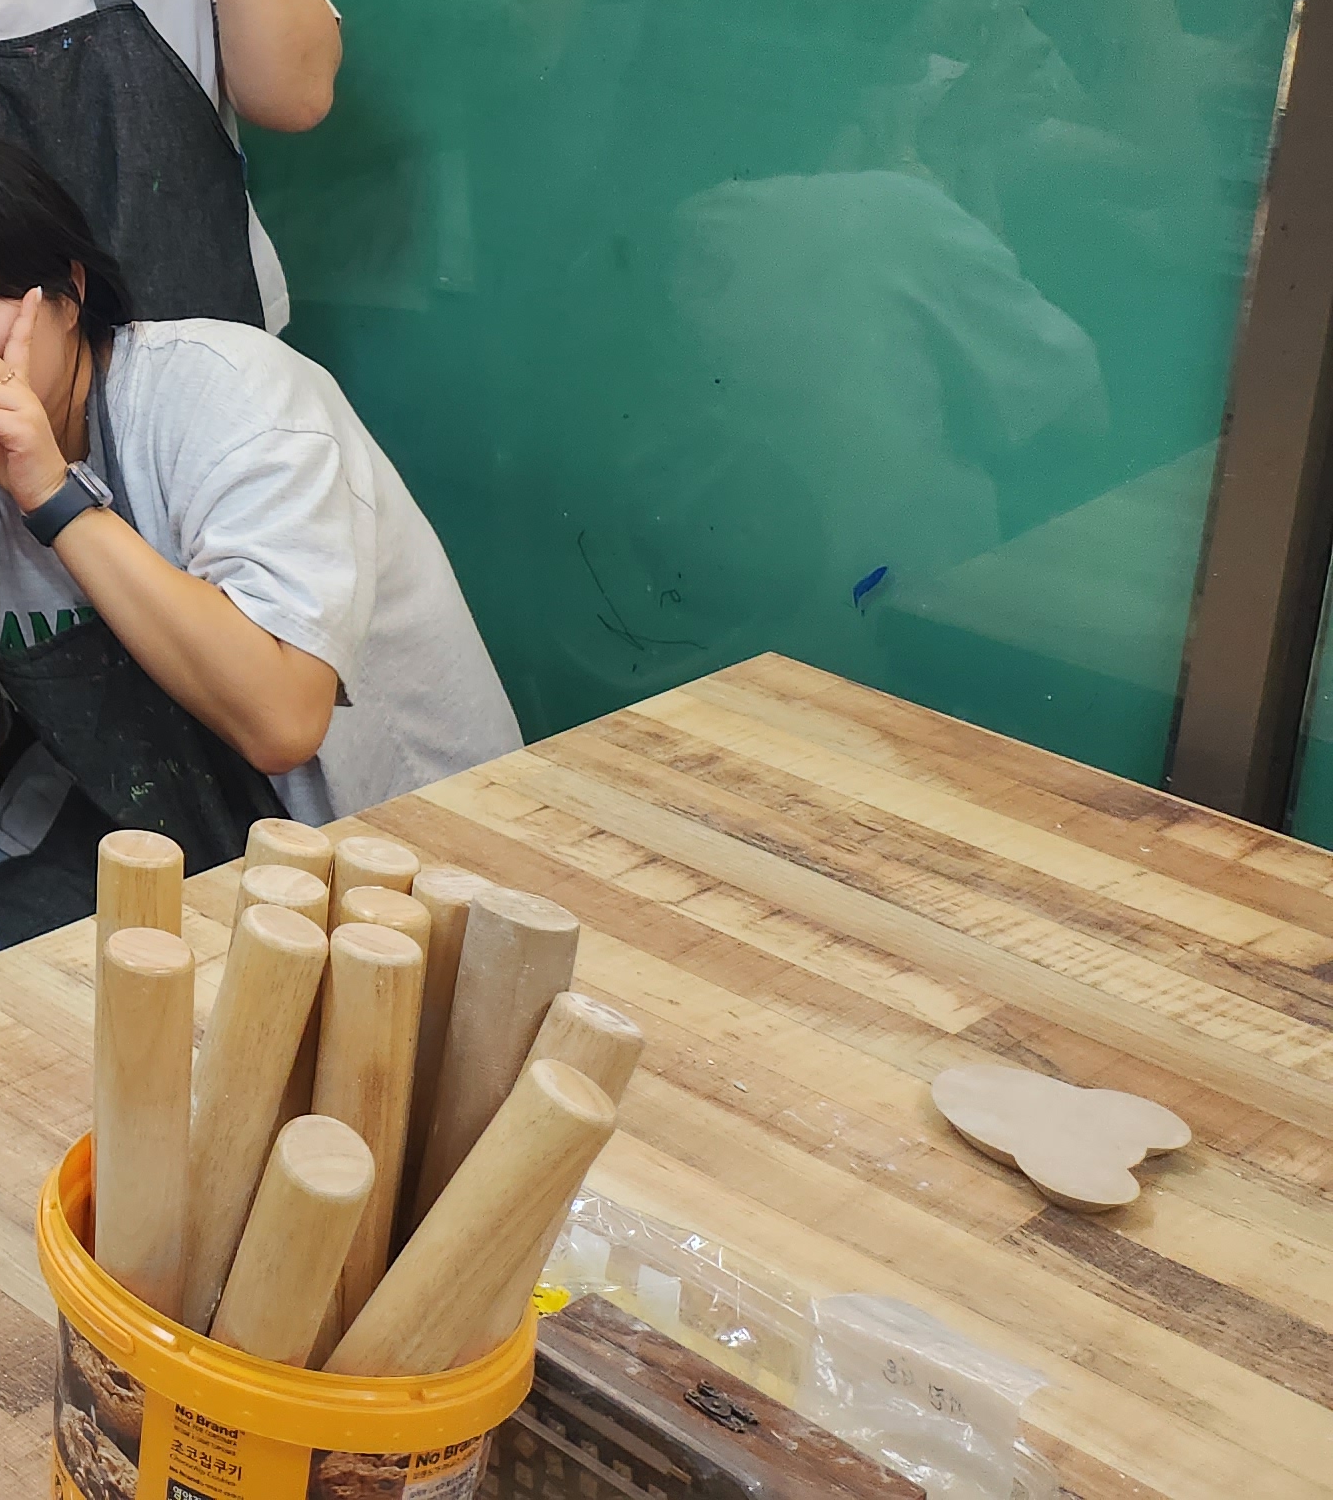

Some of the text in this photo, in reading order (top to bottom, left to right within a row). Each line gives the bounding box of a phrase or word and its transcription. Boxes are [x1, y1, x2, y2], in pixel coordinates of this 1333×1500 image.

[175, 1403, 194, 1421] No
[196, 1413, 239, 1440] Brand
[170, 1439, 243, 1481] 초코칩쿠키
[415, 1450, 441, 1469] No
